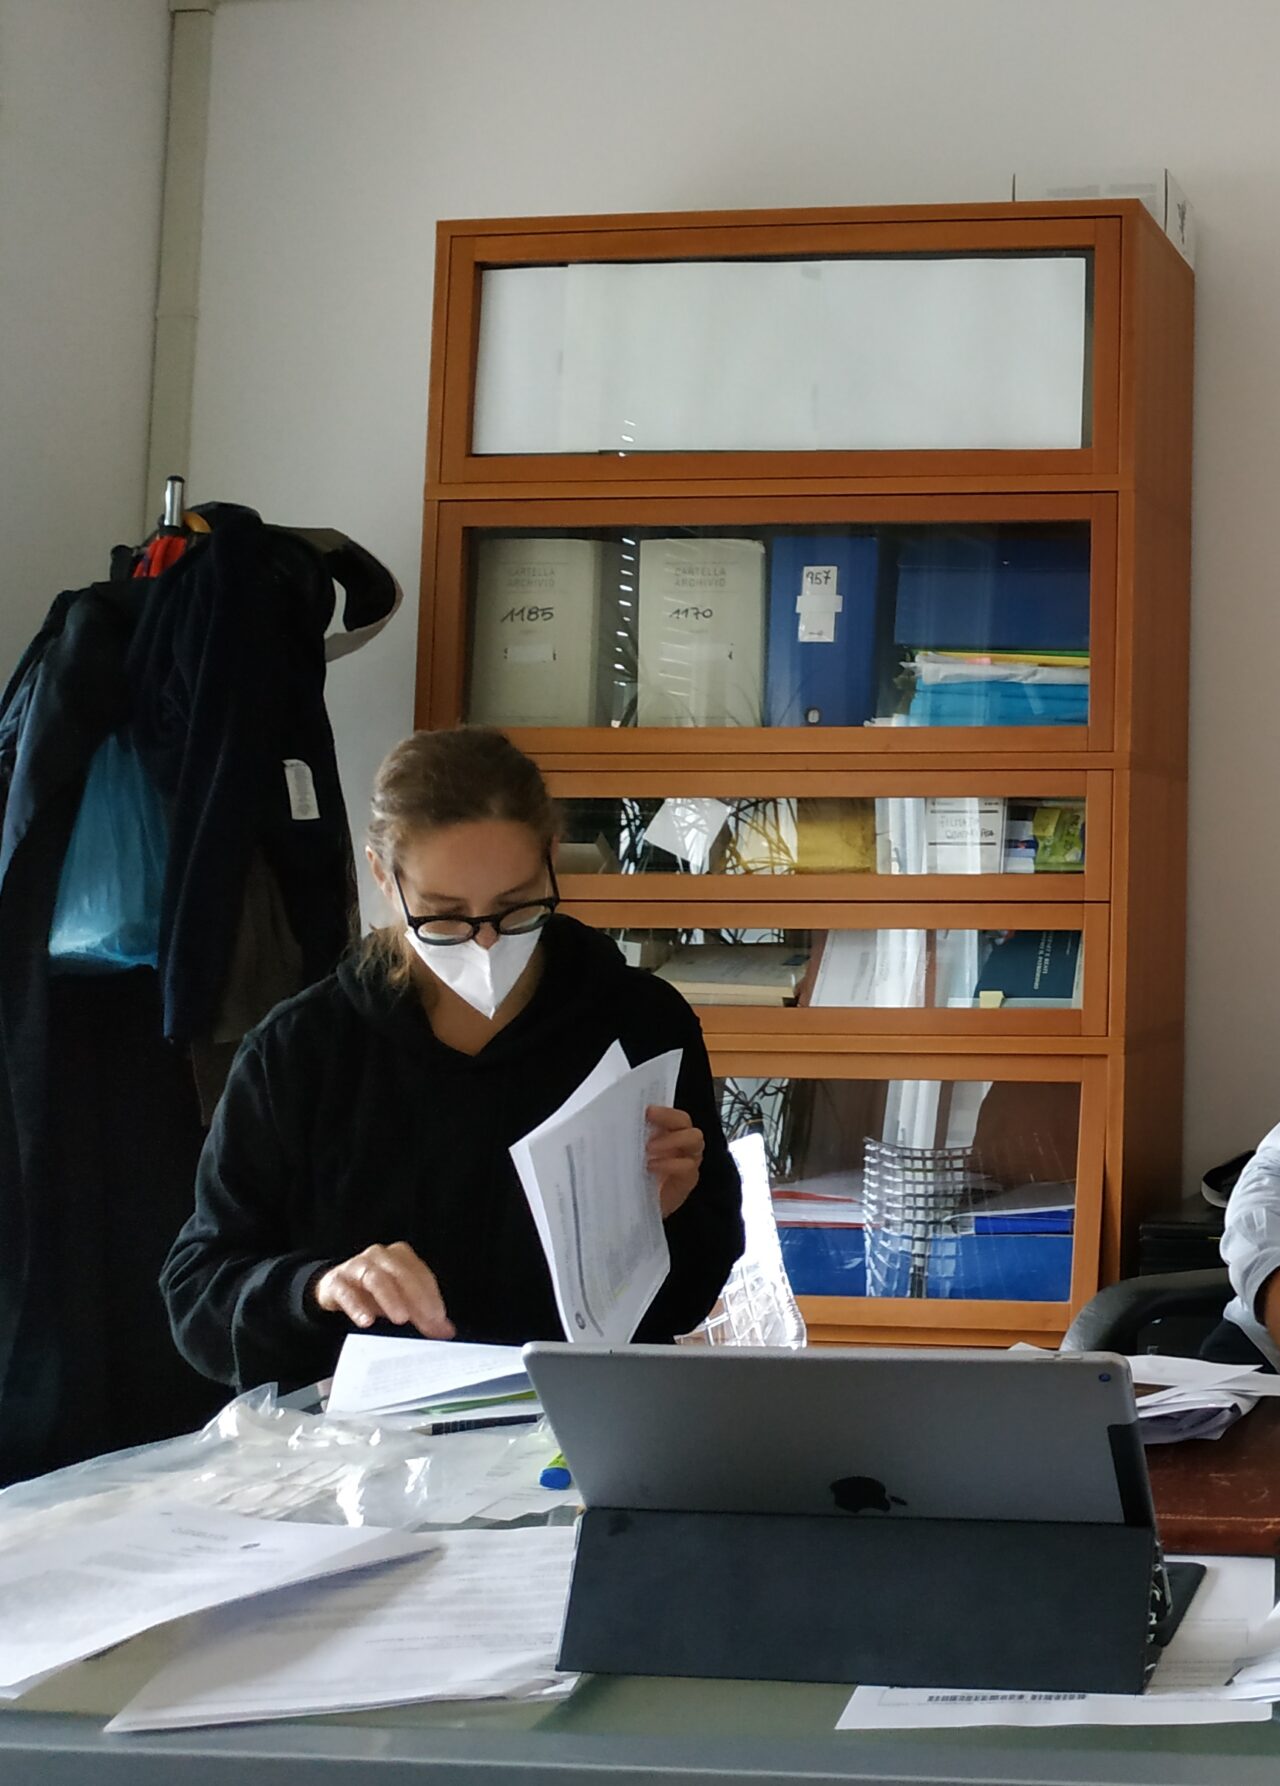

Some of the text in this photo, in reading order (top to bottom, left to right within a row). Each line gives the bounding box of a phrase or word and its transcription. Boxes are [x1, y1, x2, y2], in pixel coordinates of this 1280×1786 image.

[674, 567, 727, 577] CARTELLA
[805, 569, 832, 586] 957
[674, 578, 727, 588] ARCHIVIO
[500, 606, 555, 624] 1185
[668, 608, 713, 620] 1170
